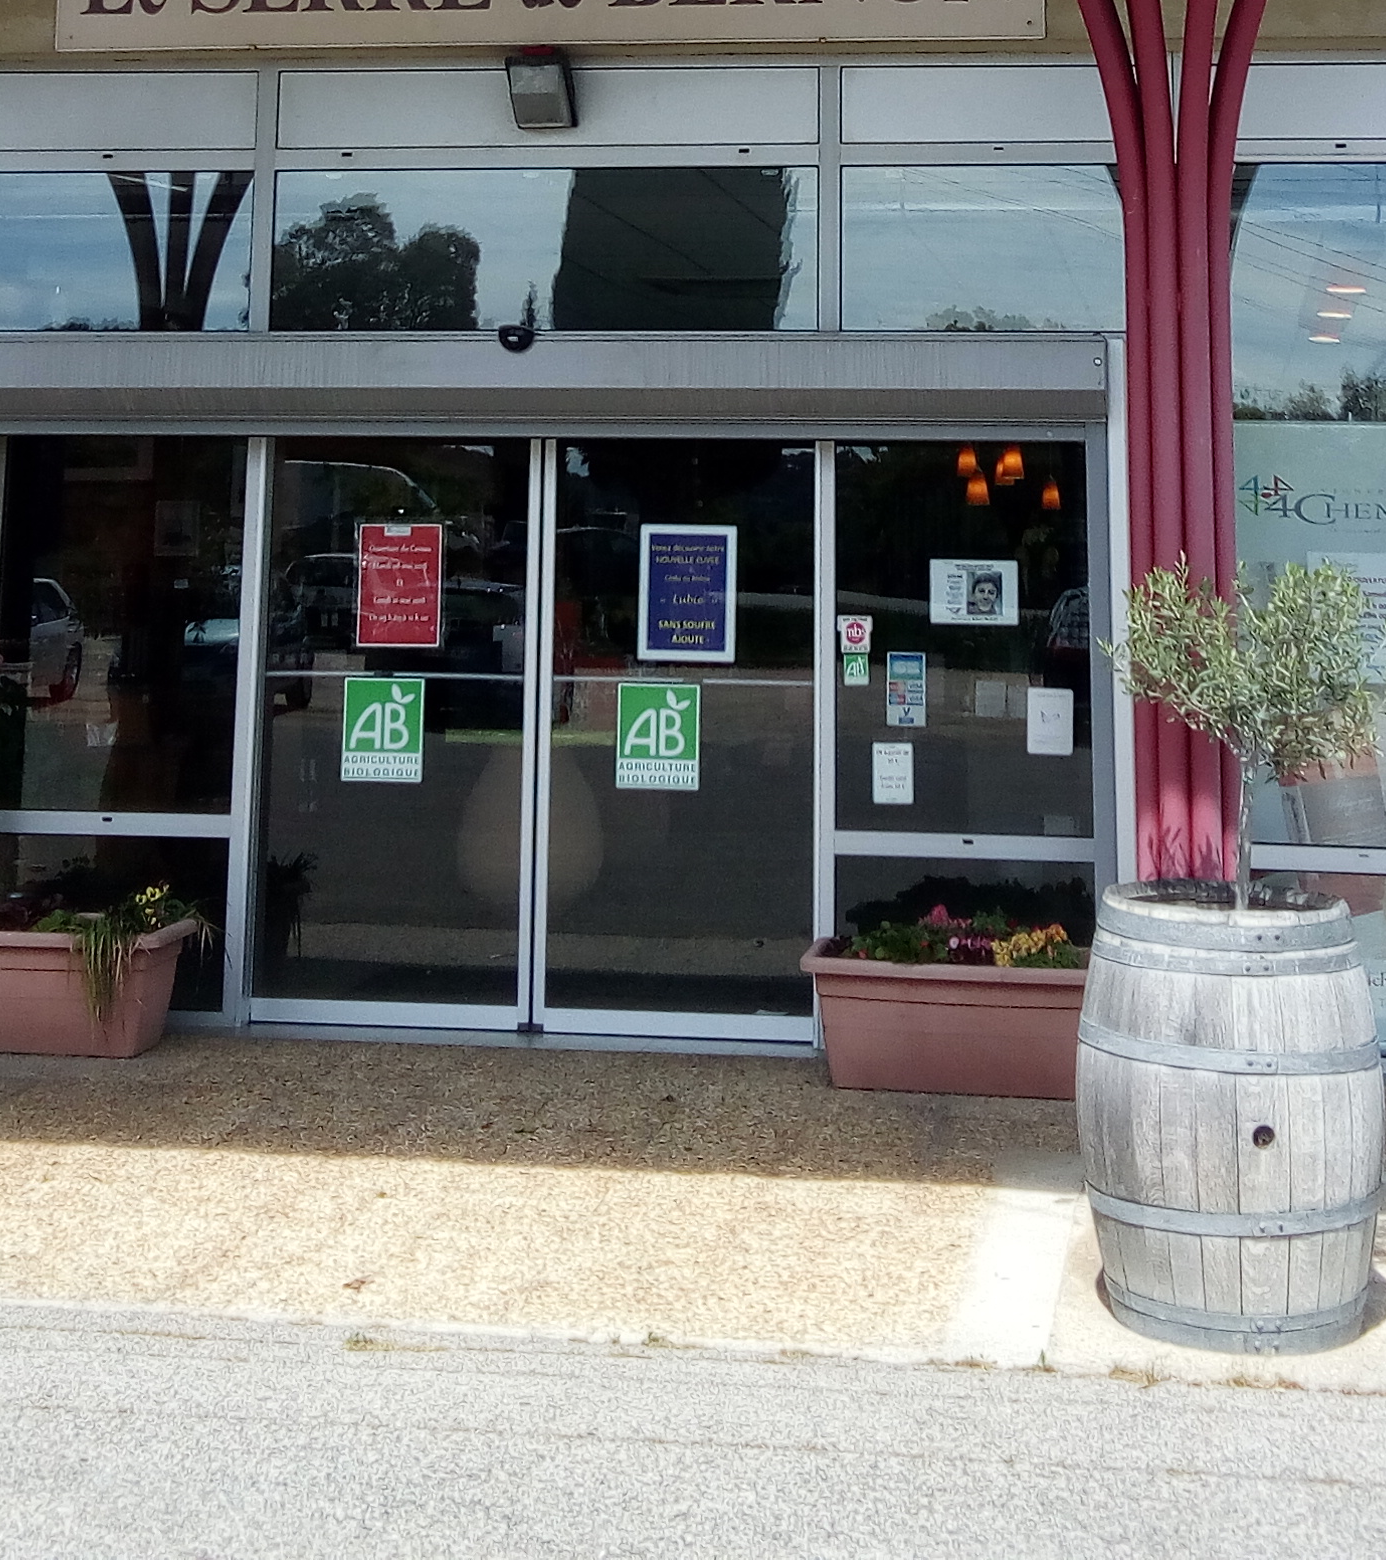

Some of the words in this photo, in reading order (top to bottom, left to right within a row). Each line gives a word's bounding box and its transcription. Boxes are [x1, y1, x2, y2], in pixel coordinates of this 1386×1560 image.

[655, 556, 694, 564] NOUVELLE
[658, 619, 681, 630] SANS
[349, 702, 410, 750] AB
[623, 708, 686, 757] AB
[343, 755, 420, 766] AGRICULTURE
[343, 767, 419, 778] BIOLOGIQUE
[618, 761, 696, 773] AGRICULTURE
[618, 773, 696, 785] BIOLOGIQUE
